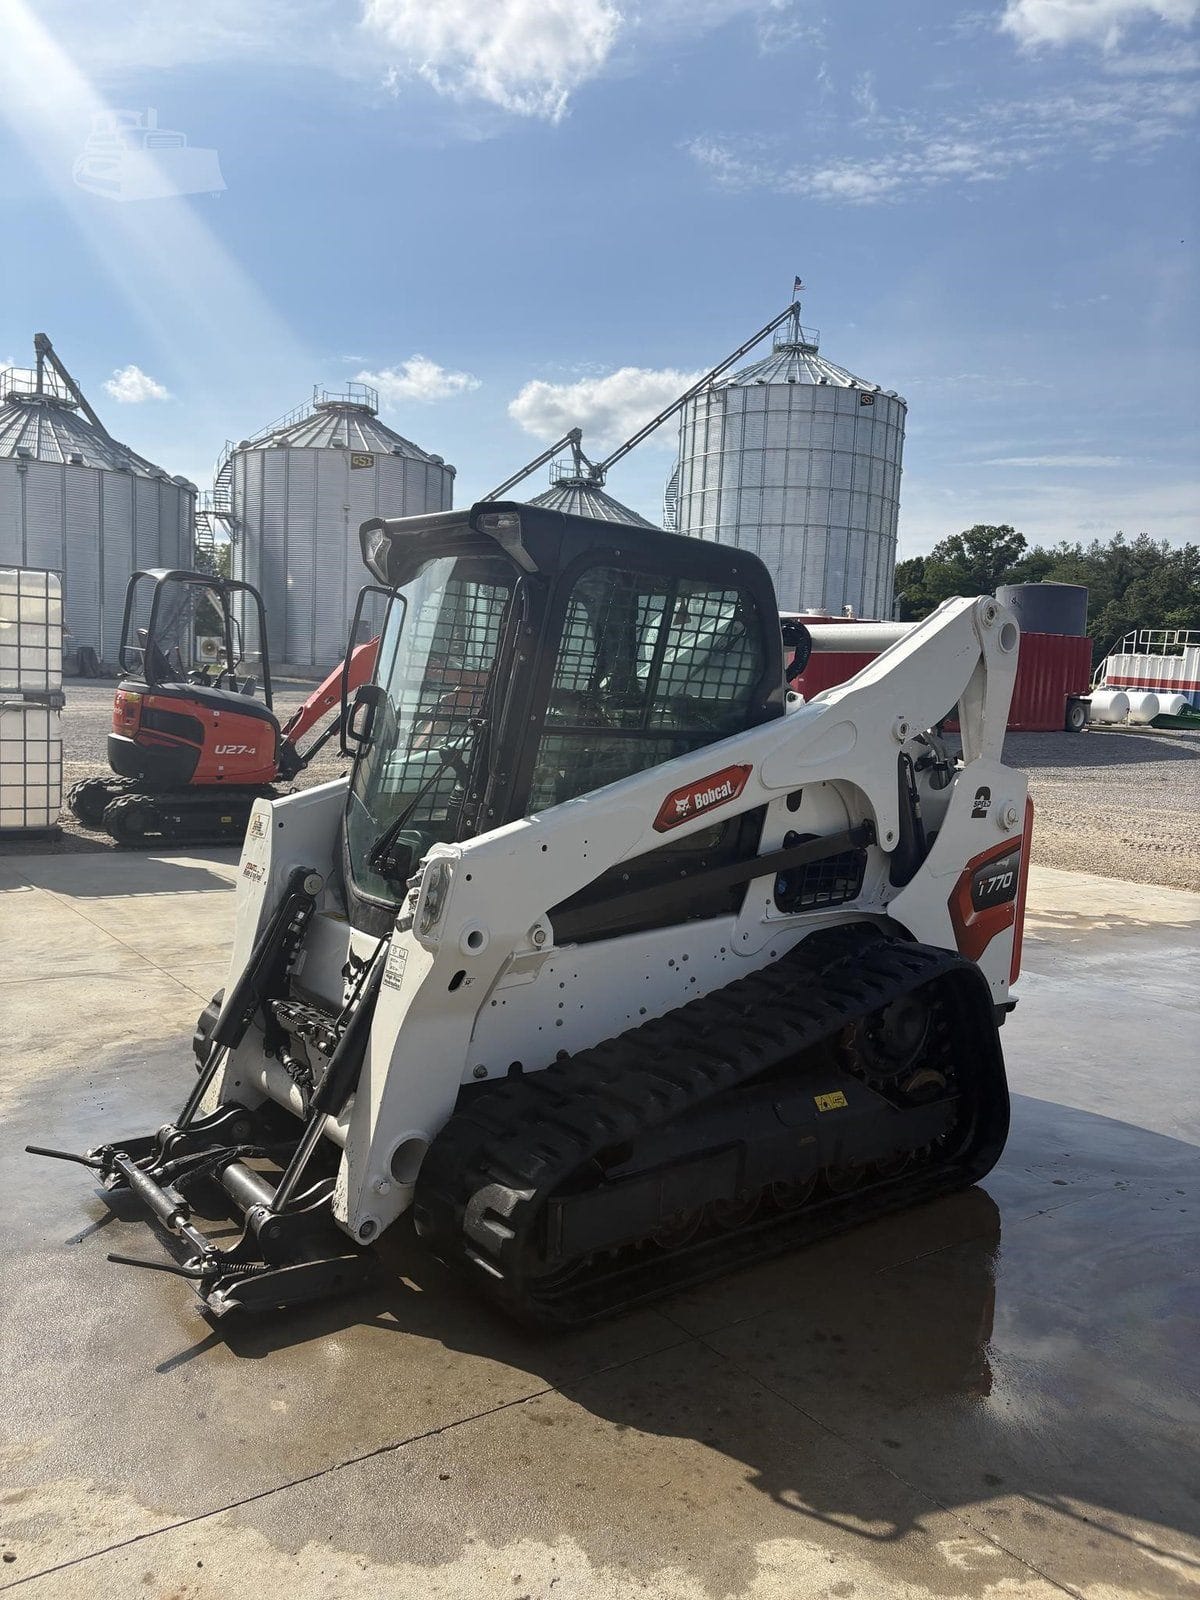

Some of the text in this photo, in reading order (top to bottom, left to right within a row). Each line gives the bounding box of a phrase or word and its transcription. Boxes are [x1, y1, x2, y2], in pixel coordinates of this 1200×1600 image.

[352, 456, 373, 467] GSI
[214, 744, 256, 755] U27-4
[694, 780, 732, 809] Bobcat
[971, 786, 991, 819] 2
[973, 800, 992, 809] SPEED
